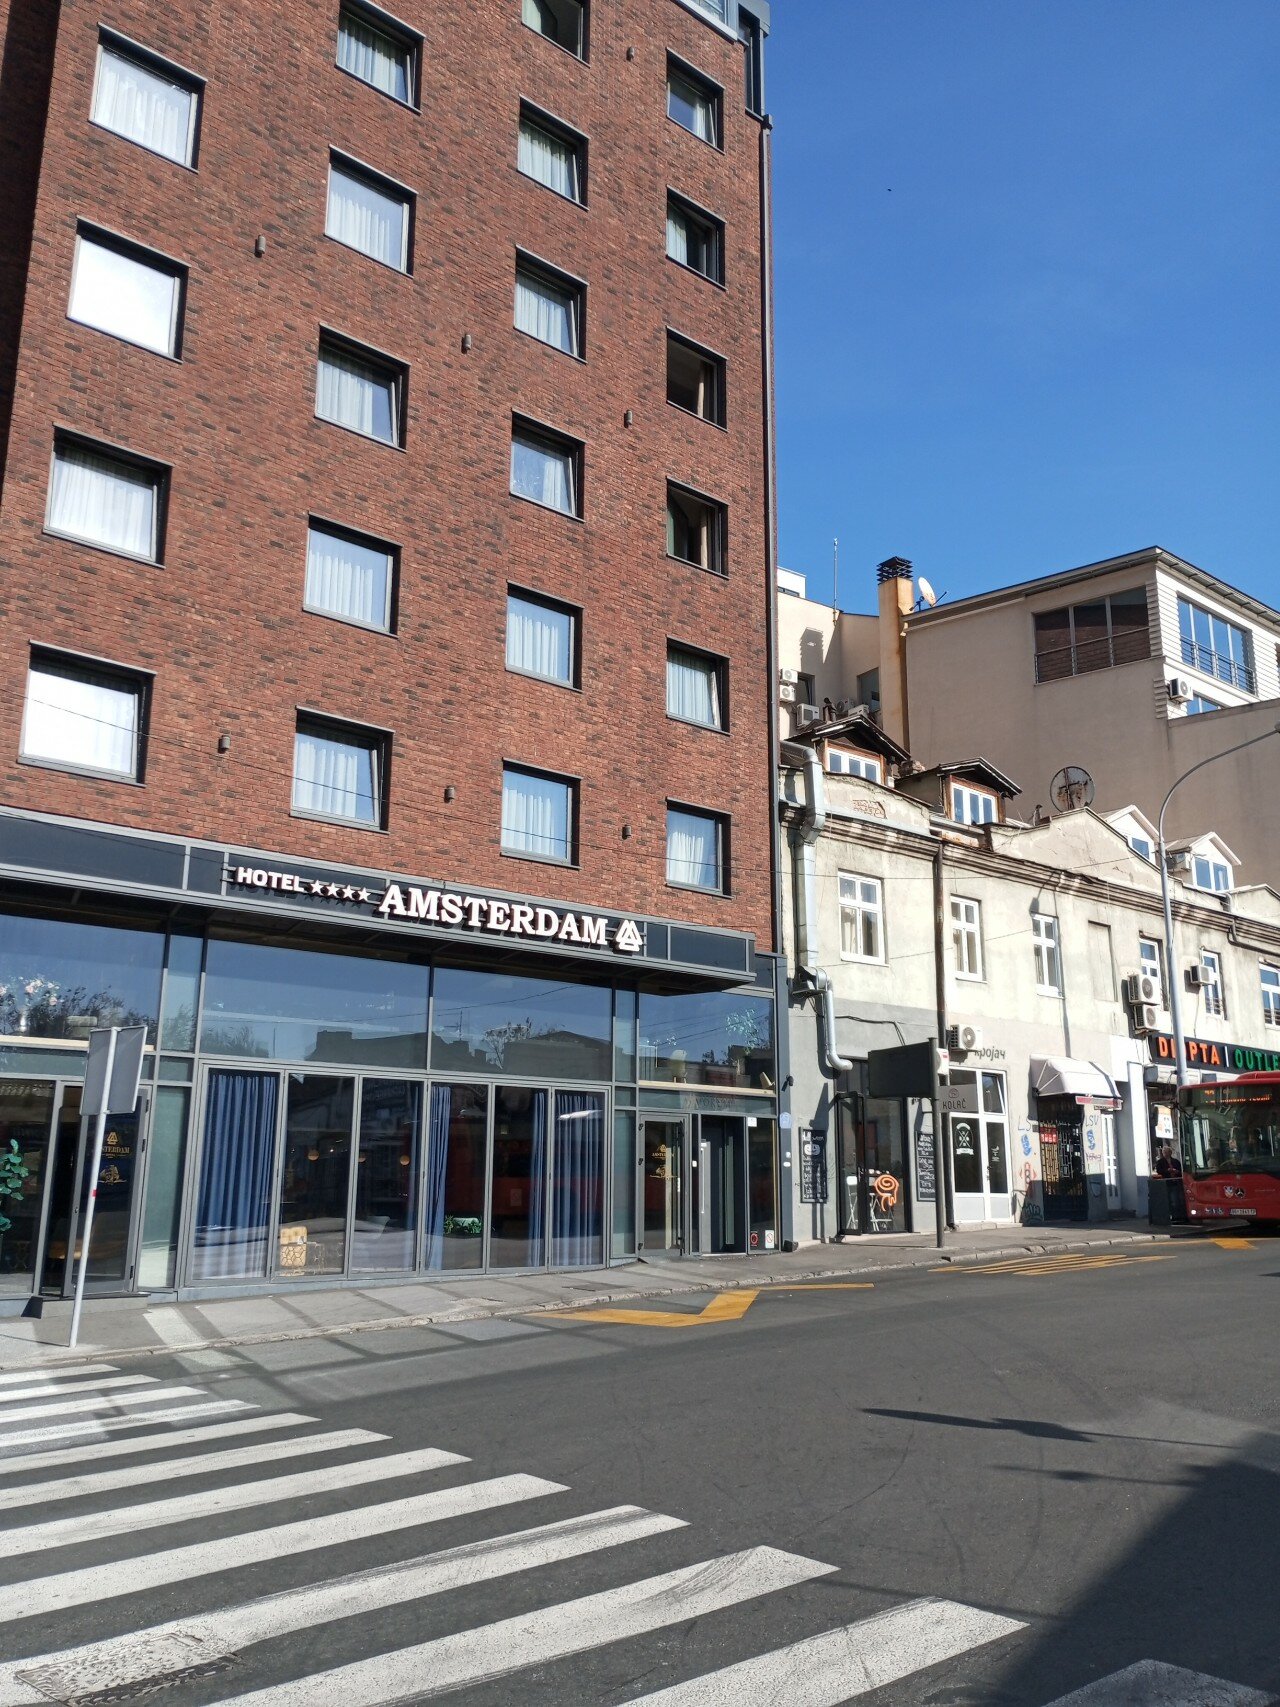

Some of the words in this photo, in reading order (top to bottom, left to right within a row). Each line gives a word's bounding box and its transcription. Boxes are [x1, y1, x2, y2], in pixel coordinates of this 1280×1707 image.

[237, 866, 305, 893] HOTEL
[379, 884, 608, 946] AMSTERDAM
[1158, 1036, 1220, 1065] DIPTA
[942, 1098, 967, 1110] KOLAČ
